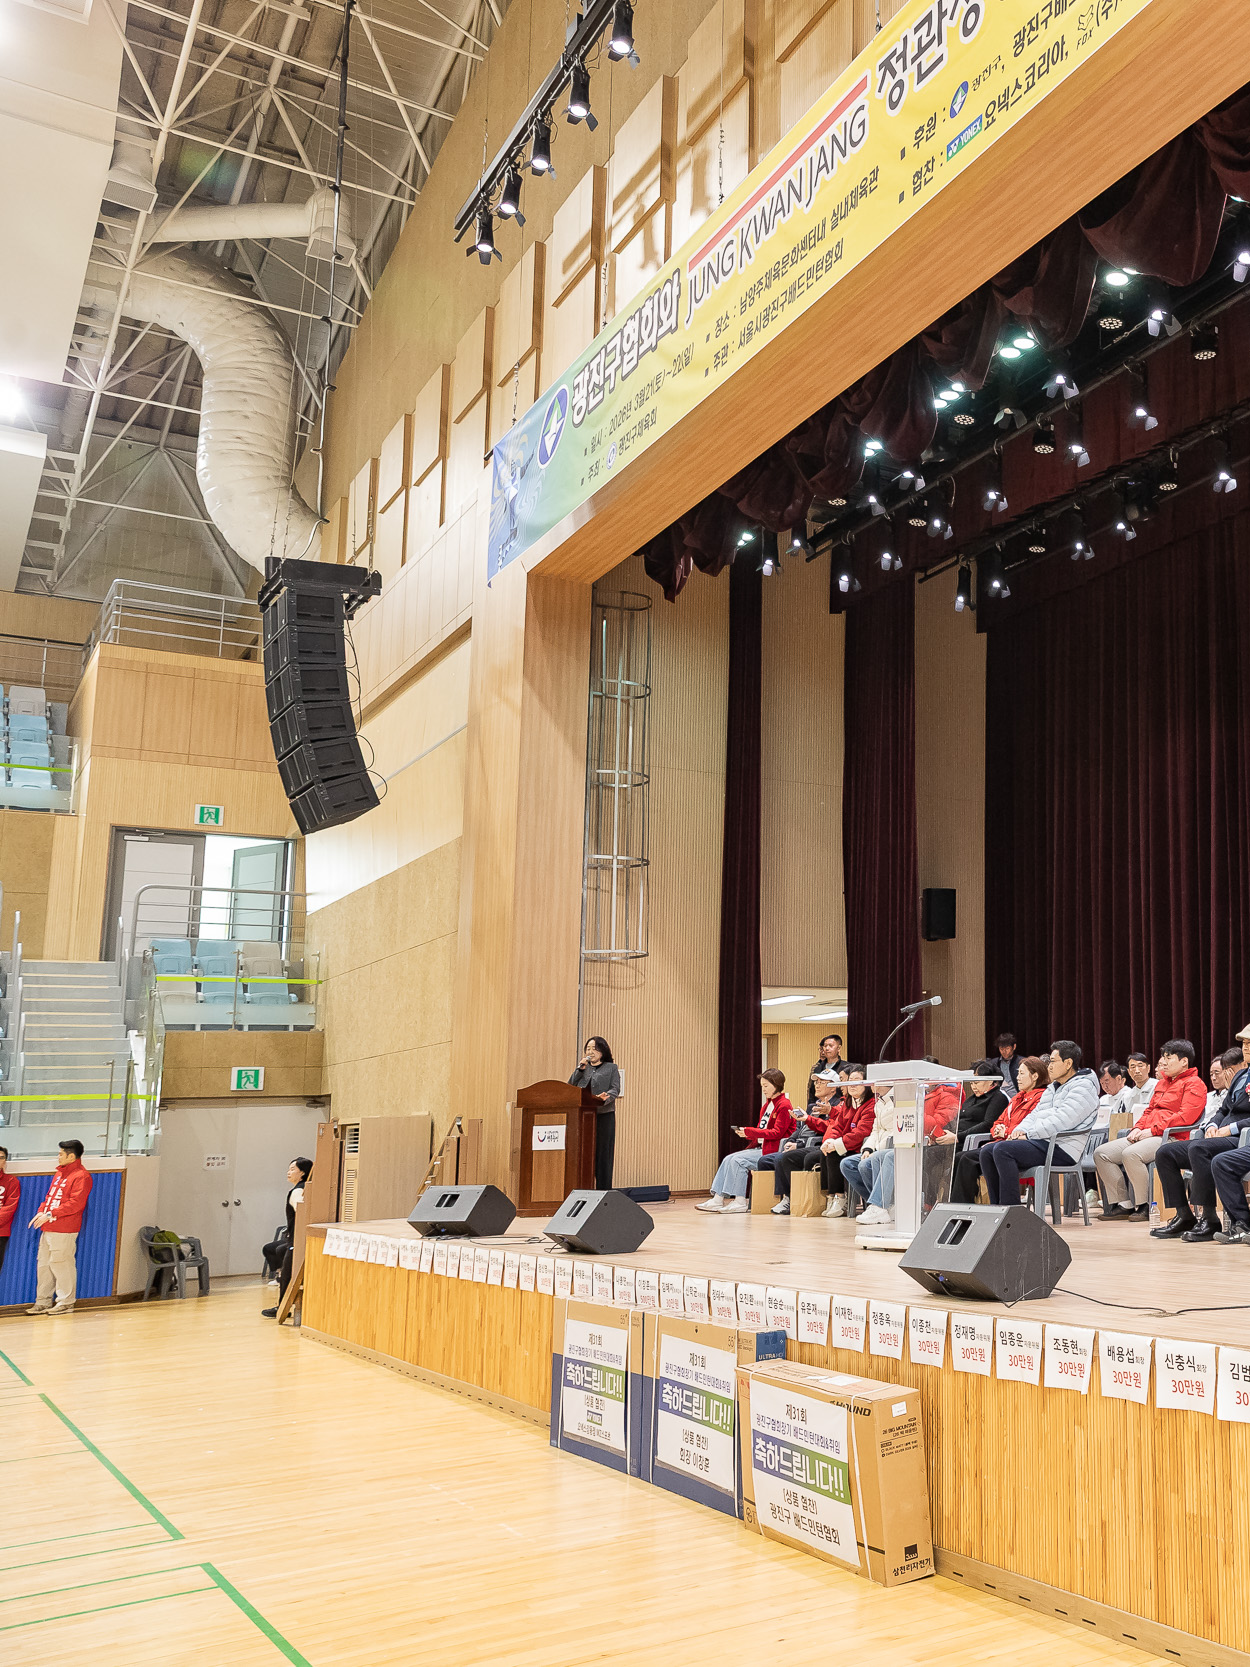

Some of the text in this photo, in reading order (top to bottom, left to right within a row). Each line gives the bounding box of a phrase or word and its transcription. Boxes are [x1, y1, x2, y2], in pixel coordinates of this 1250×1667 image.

[913, 112, 937, 150] 후원
[1013, 0, 1077, 58] 광진구배
[912, 156, 935, 196] 협찬
[959, 117, 983, 147] YONEX
[984, 34, 1069, 131] 요넥스코리아,
[714, 165, 880, 339] 장소 남양주체육문화센터내 실내체육관
[572, 268, 681, 428] 광진구협회와
[686, 239, 735, 324] JUNG
[740, 168, 803, 269] KWAN
[806, 104, 866, 208] JANG
[713, 237, 845, 373] 주관 서울시광진구배드민턴협회
[590, 432, 603, 453] 일시
[609, 406, 633, 436] 2026년
[618, 406, 658, 457] 광진구체육회
[772, 1315, 791, 1329] 30만원
[806, 1321, 825, 1335] 30만원
[841, 1326, 860, 1341] 30만원
[878, 1332, 899, 1348] 30만원
[758, 1353, 776, 1361] ULTRA
[918, 1339, 941, 1355] 30만원
[961, 1347, 986, 1363] 30만원
[689, 1352, 707, 1370] 제31회
[1008, 1353, 1034, 1371] 30만원
[1058, 1361, 1086, 1379] 30만원
[566, 1361, 623, 1399] 축하드립니다!!
[1112, 1369, 1142, 1389] 30만원
[1171, 1379, 1206, 1399] 30만원
[662, 1382, 731, 1432] 축하드립니다!!
[785, 1403, 808, 1425] 제31회
[756, 1413, 792, 1437] 광진구협회장기
[680, 1447, 691, 1465] 회장
[754, 1437, 845, 1499] 축하드립니다!!
[782, 1488, 818, 1515] (상품 협찬)
[769, 1502, 792, 1525] 광진구
[793, 1511, 841, 1546] 배드민턴협회
[892, 1557, 931, 1577] 삼천리자전거
